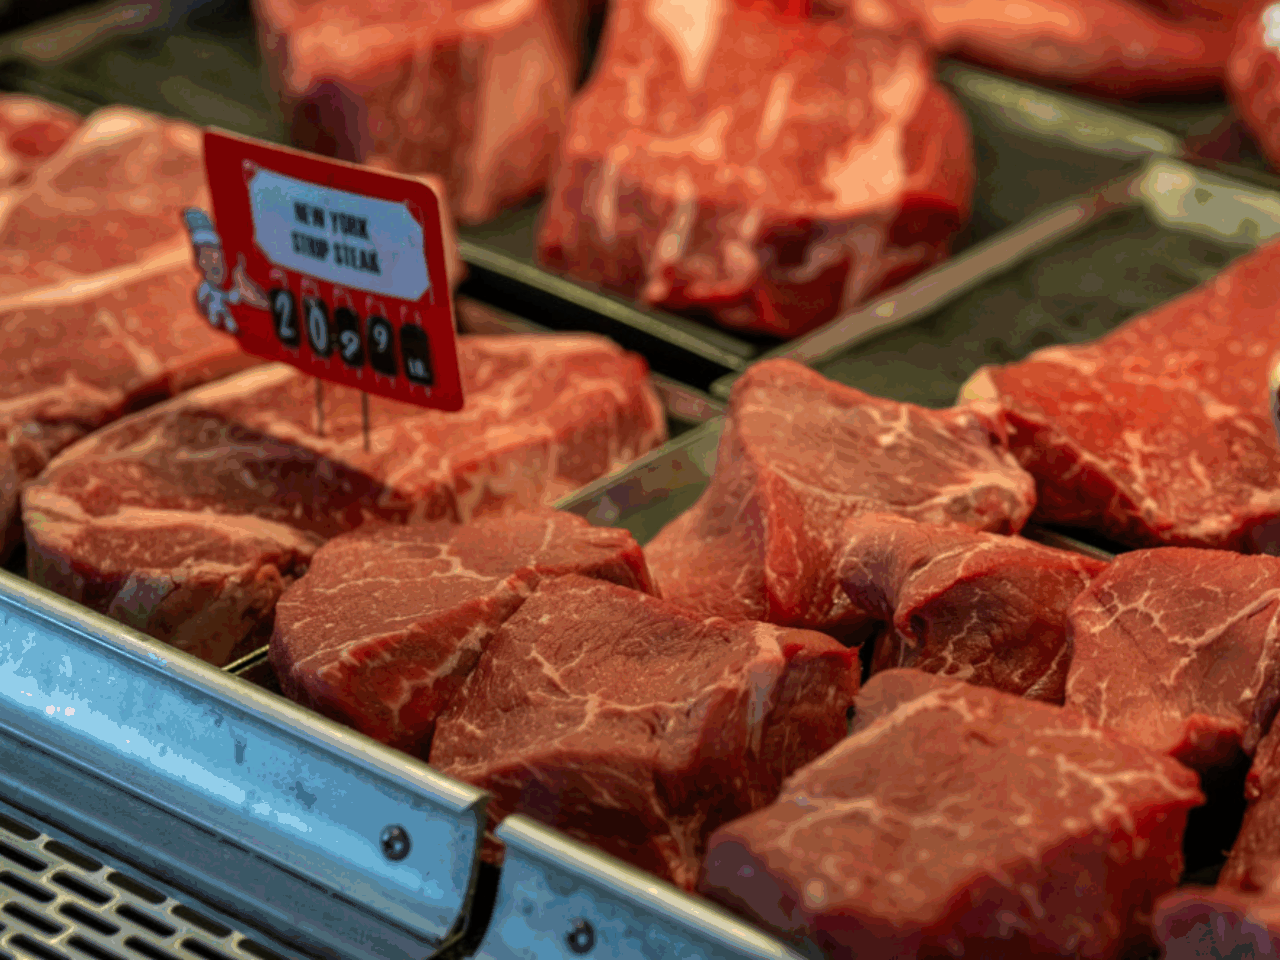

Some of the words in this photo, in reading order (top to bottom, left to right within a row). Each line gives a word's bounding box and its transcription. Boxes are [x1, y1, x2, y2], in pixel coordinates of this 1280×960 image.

[293, 201, 326, 230] NEW
[329, 210, 370, 241] YORK
[290, 230, 331, 262] STRIP
[333, 241, 383, 277] STEAK
